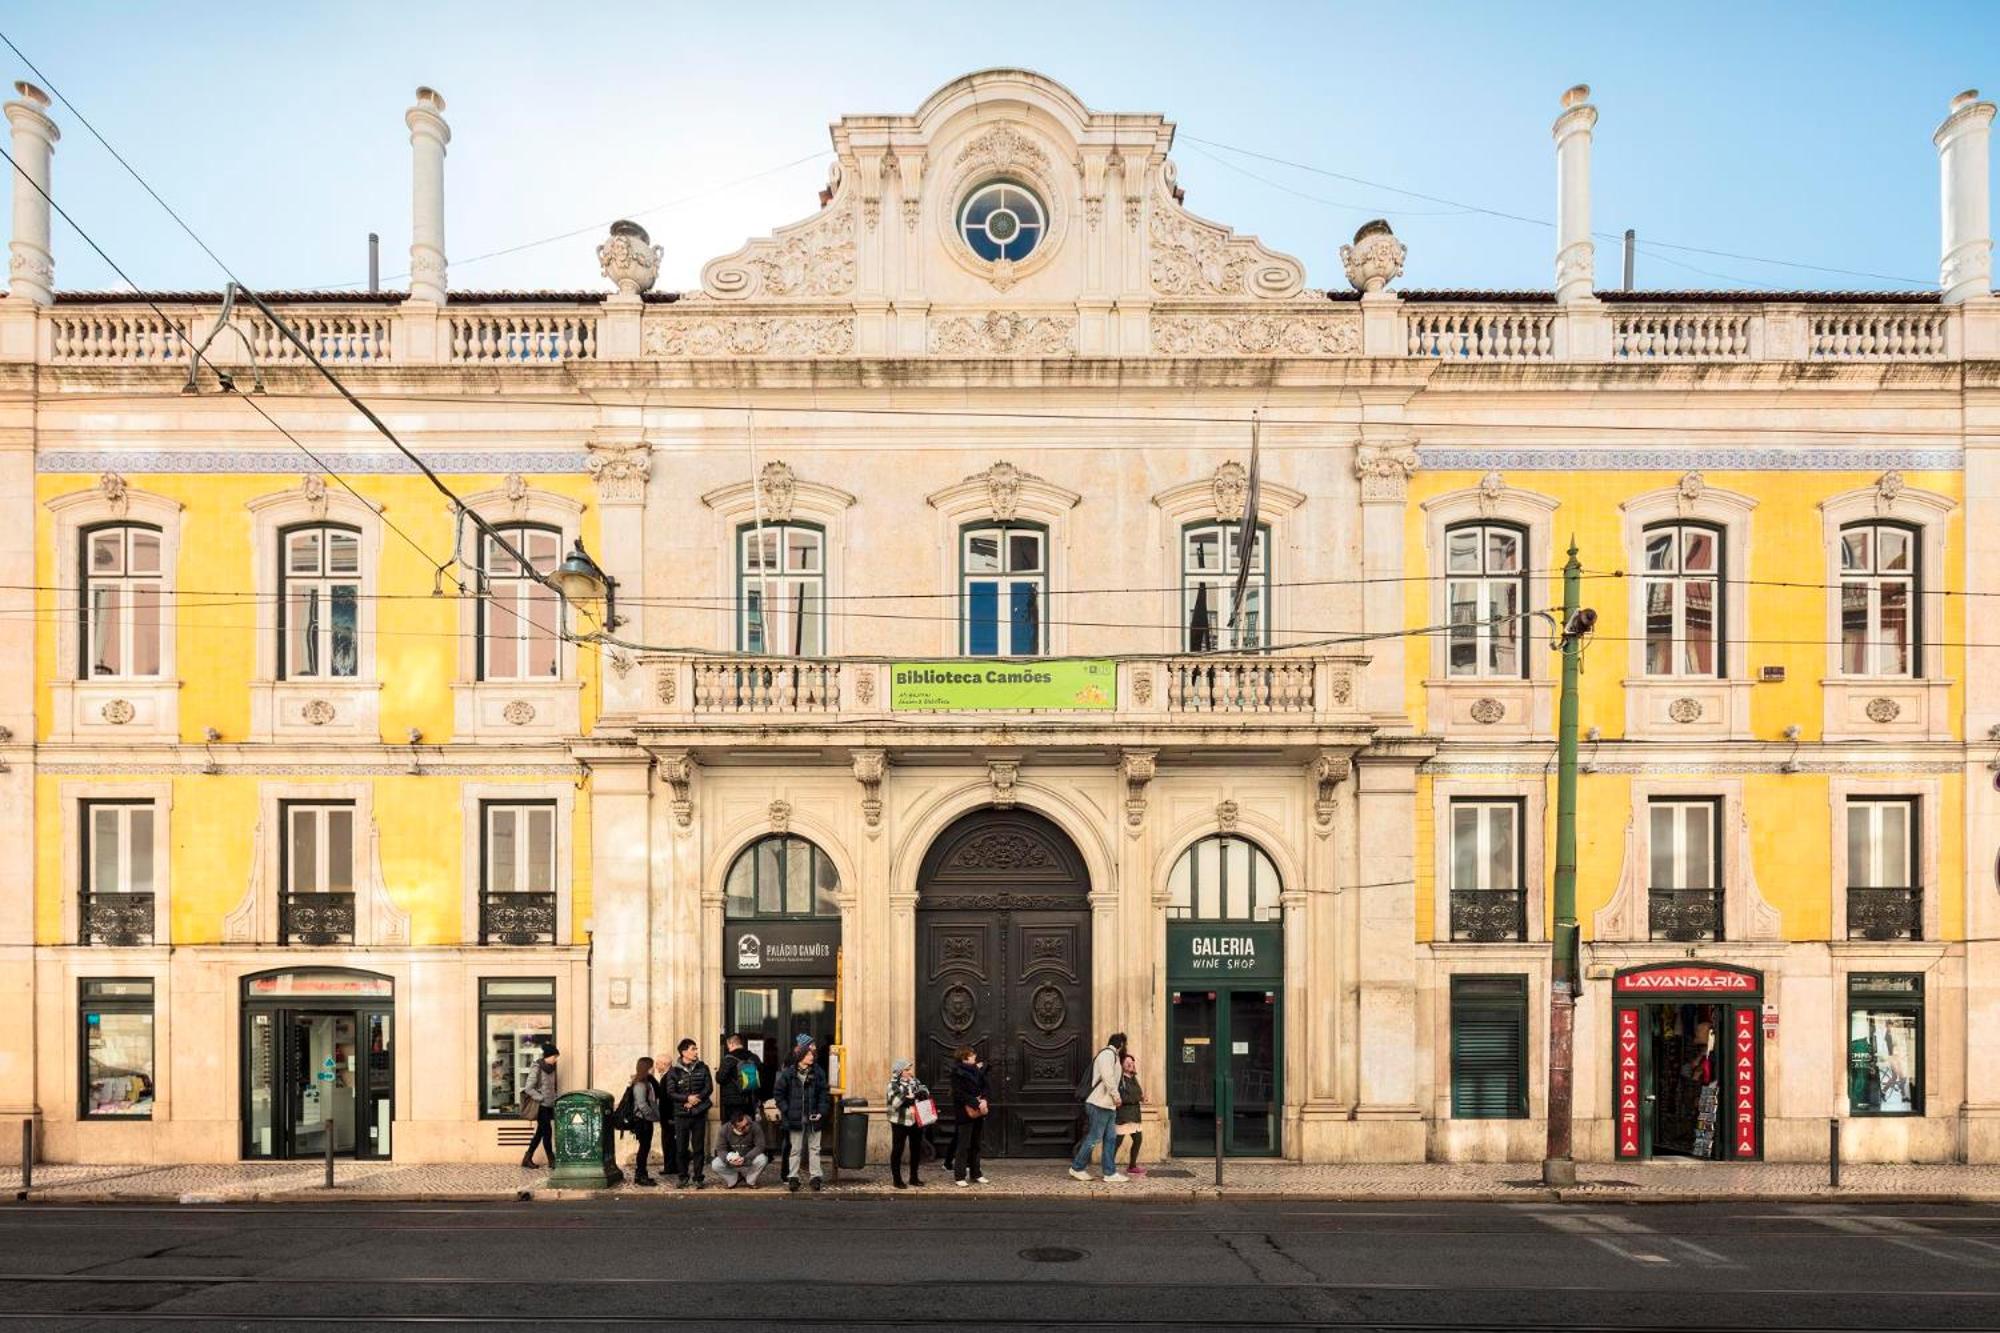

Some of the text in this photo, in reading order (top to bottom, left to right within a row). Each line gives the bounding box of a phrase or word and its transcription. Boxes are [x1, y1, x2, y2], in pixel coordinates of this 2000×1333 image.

[896, 669, 1052, 685] Biblioteca Camões
[766, 943, 830, 957] PALÁCIO CAMÕES
[1192, 937, 1254, 955] GALERIA
[1192, 958, 1256, 970] WINE SHOP
[1625, 977, 1747, 987] LAVANDARIA
[1622, 1014, 1636, 1150] LAVANDARIA
[1738, 1014, 1752, 1150] LAVANDARIA
